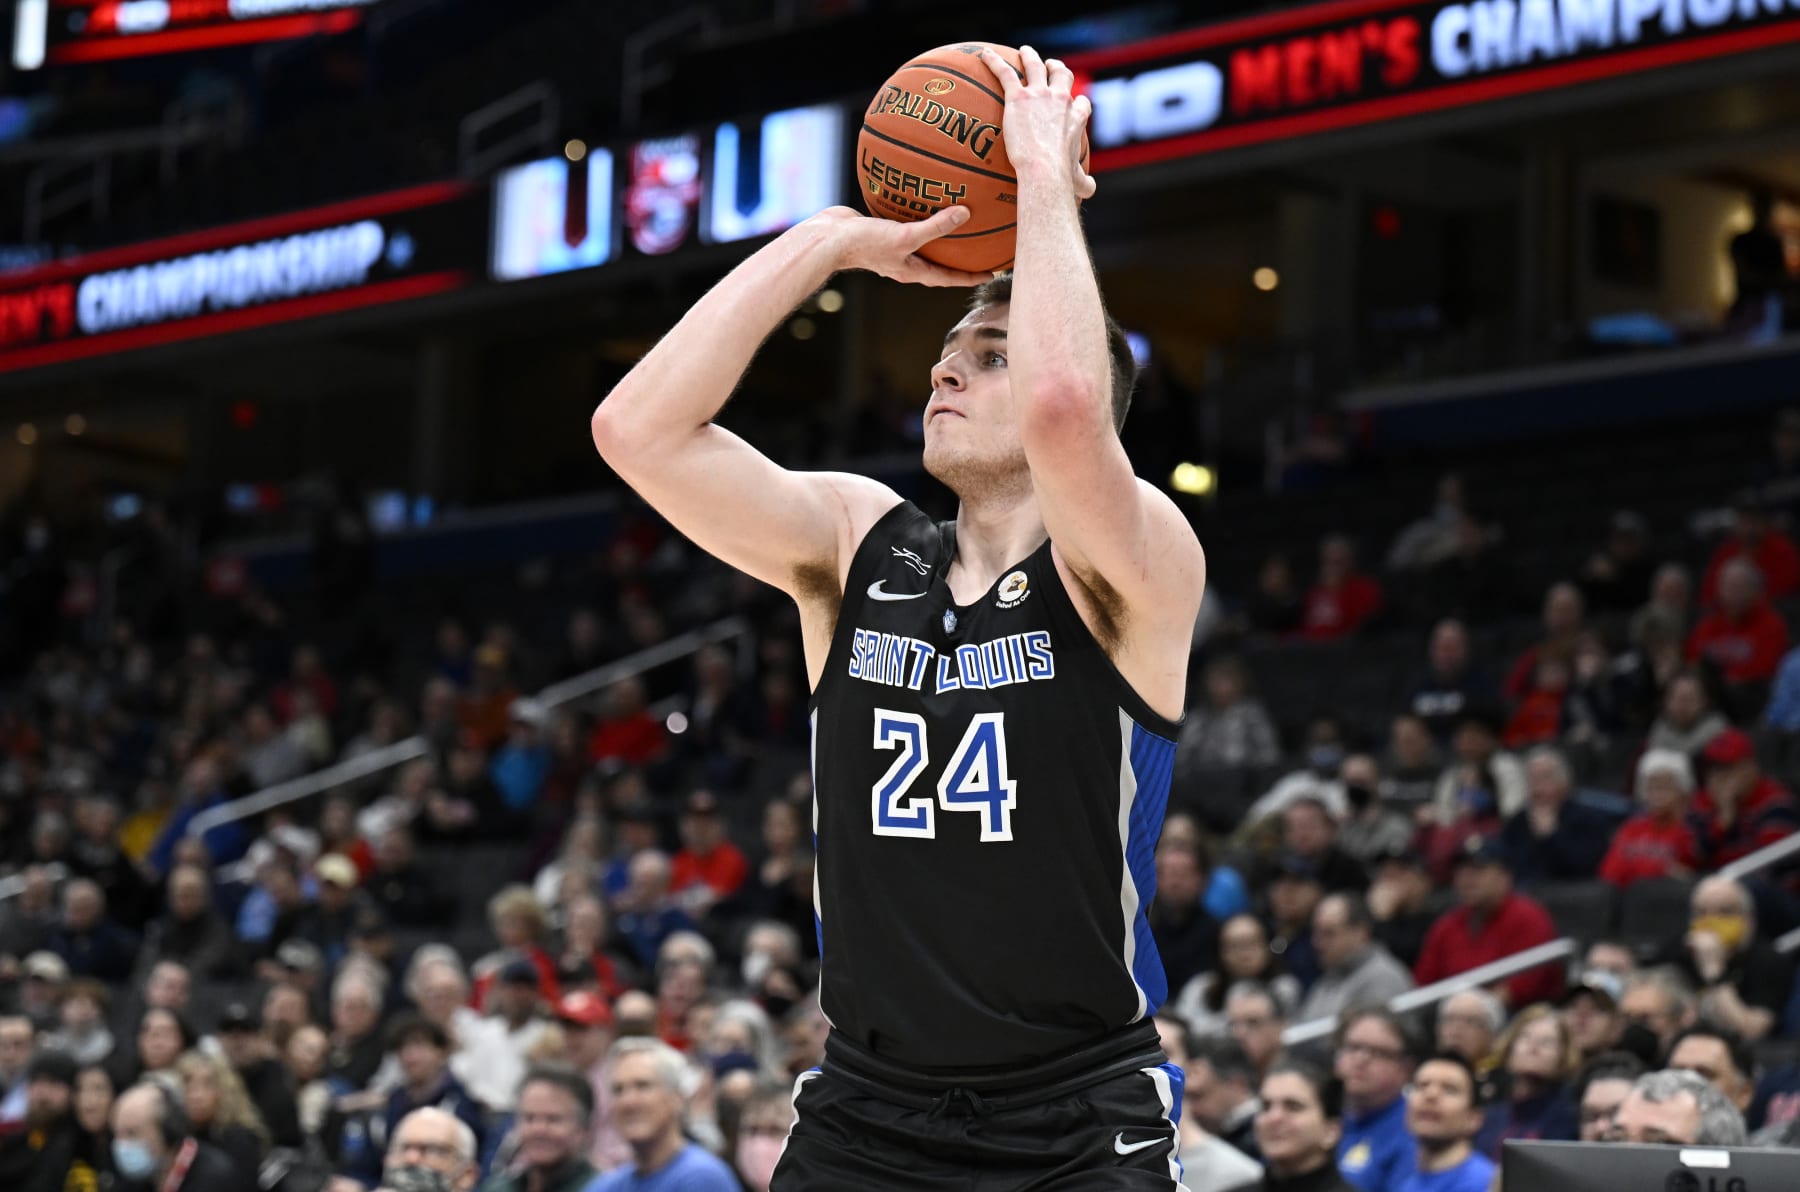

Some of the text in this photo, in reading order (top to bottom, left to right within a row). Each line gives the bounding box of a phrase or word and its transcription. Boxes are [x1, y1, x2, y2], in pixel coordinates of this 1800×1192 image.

[1229, 17, 1419, 113] MEN'S
[1431, 0, 1800, 77] CHAMP
[870, 85, 1001, 160] SPALDING
[861, 148, 967, 205] LEGACY
[849, 627, 1055, 695] SAINT LOUIS
[872, 708, 1017, 843] 24
